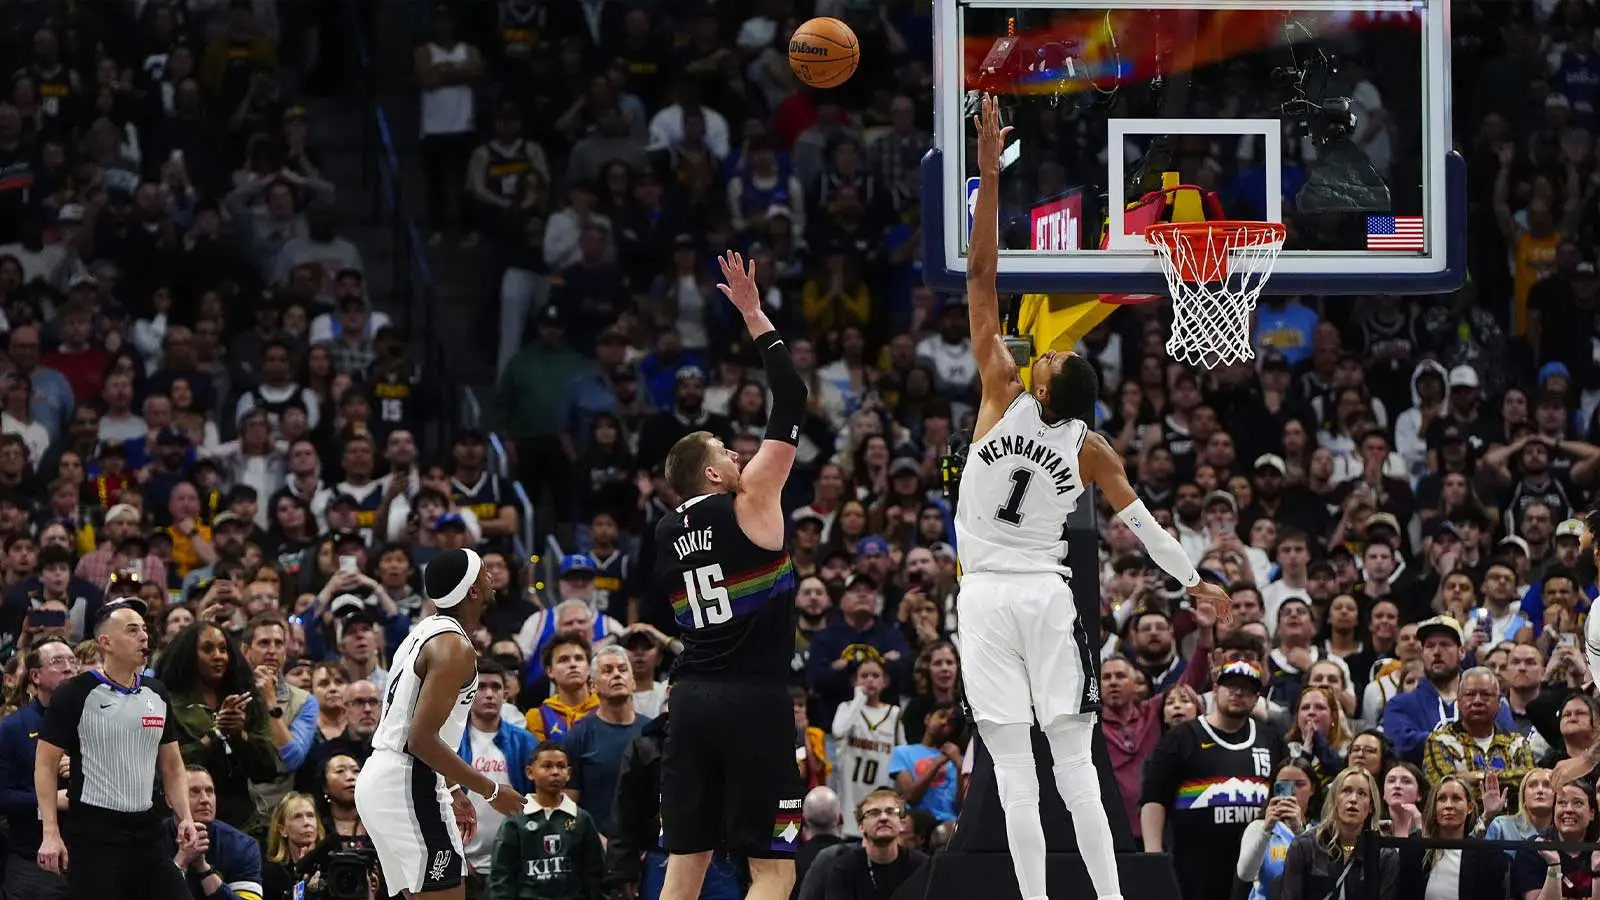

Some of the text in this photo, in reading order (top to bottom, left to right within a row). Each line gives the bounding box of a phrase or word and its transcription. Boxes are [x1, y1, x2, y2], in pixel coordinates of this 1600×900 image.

[790, 41, 828, 56] Wilson
[978, 435, 1075, 495] WEMBANYAMA
[993, 466, 1036, 528] 1
[673, 526, 713, 560] JOKIĆ
[682, 563, 733, 629] 15
[852, 755, 879, 785] 10
[1252, 753, 1271, 777] 15
[779, 799, 802, 809] NUGGET
[1214, 806, 1262, 824] DENVE
